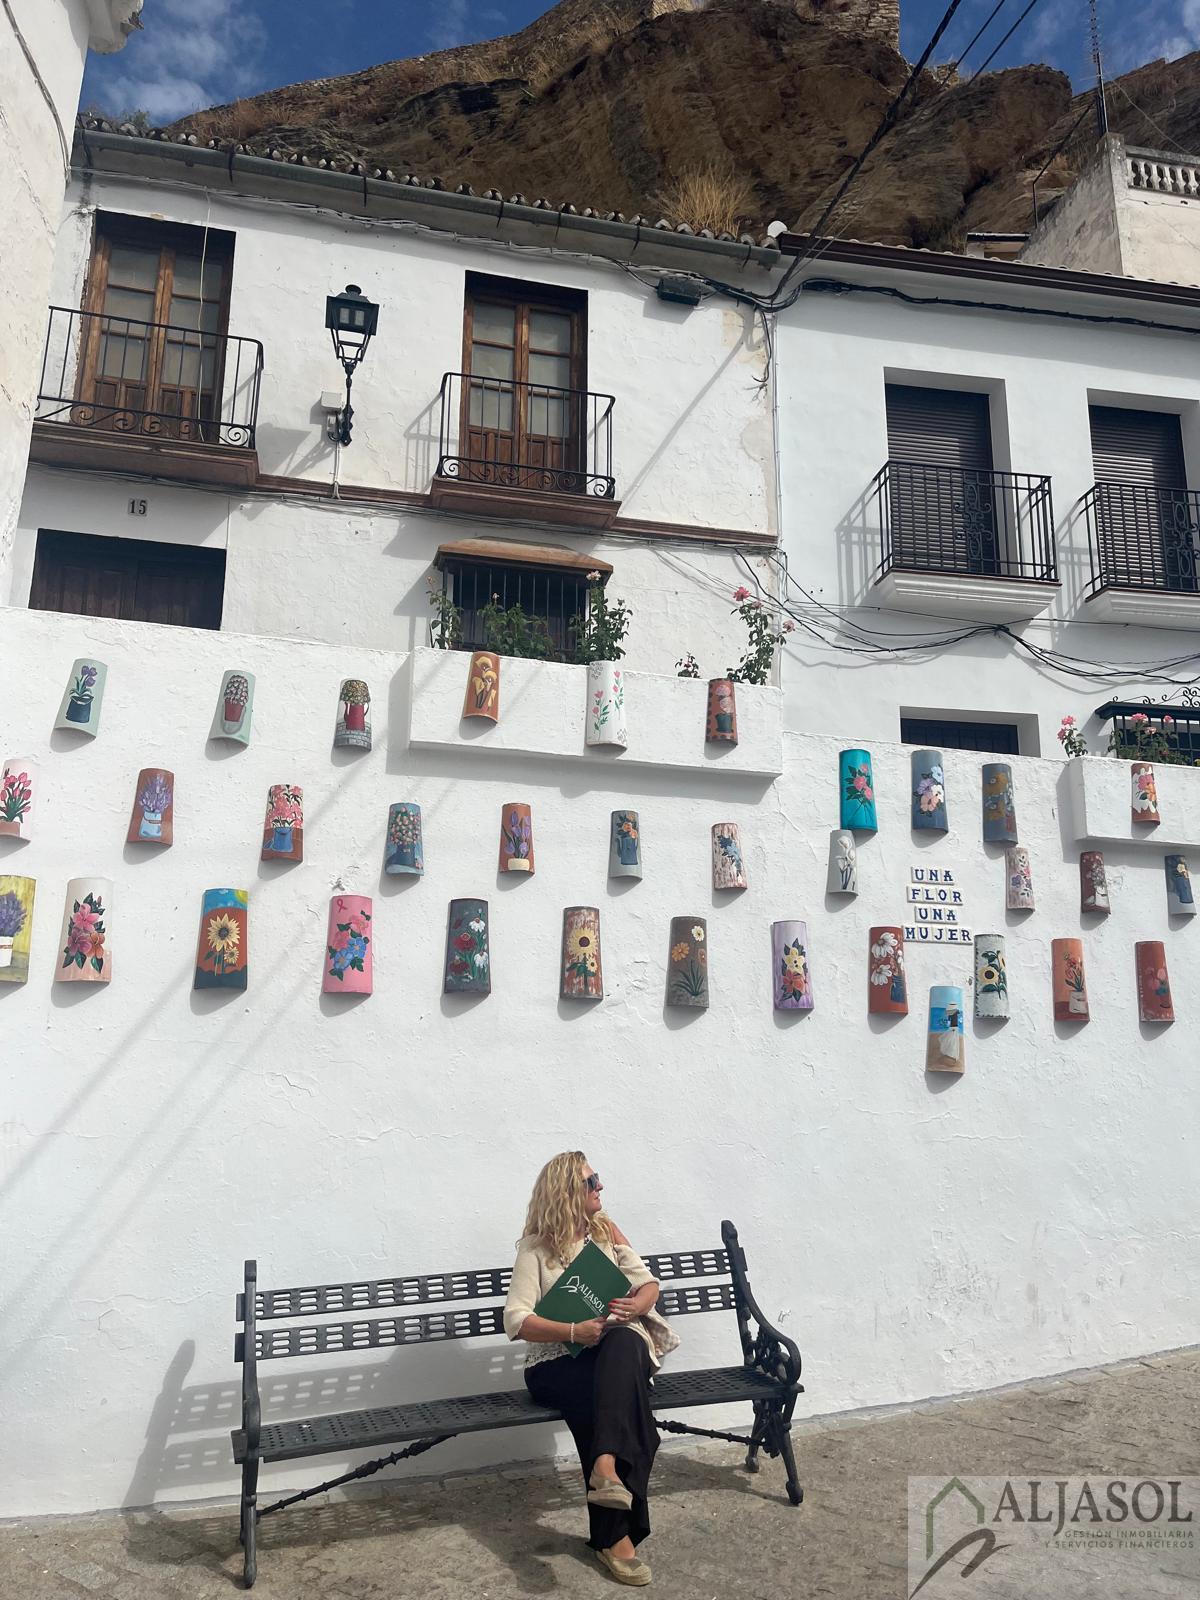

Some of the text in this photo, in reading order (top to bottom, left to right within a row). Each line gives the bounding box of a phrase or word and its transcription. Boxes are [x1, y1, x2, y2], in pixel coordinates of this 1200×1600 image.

[130, 499, 146, 515] 15
[914, 869, 953, 881] UNA
[911, 888, 962, 902] FLOR
[918, 908, 956, 920] UNA
[905, 927, 971, 941] MUJER
[578, 1283, 605, 1314] ALJASOL
